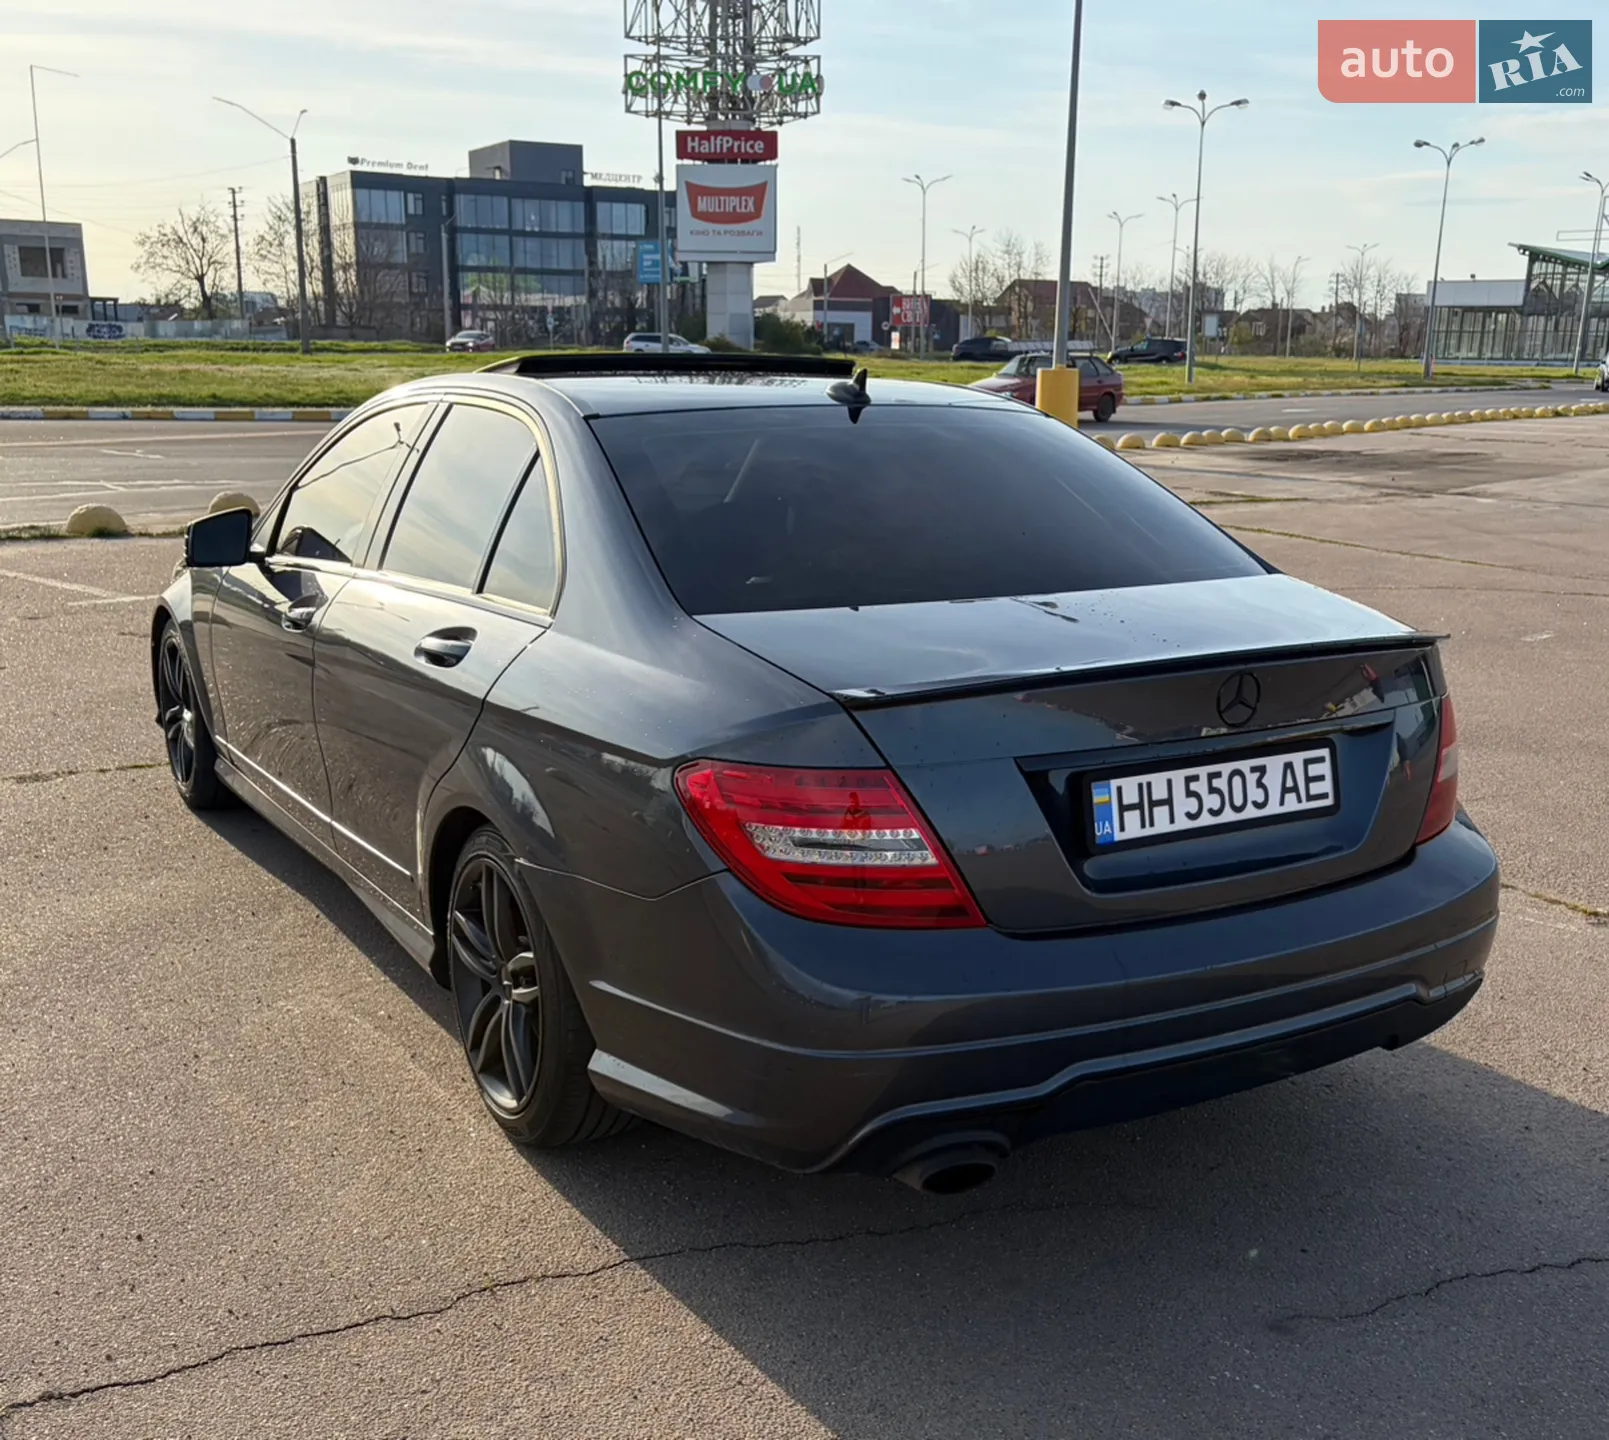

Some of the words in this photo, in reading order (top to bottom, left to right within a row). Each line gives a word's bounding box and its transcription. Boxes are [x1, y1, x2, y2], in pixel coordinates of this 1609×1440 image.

[627, 70, 747, 95] COMFY
[687, 135, 765, 154] HalfPrice
[360, 157, 404, 169] Premium
[697, 195, 756, 213] MULTIPLEX
[1116, 777, 1176, 833] HH
[1183, 763, 1270, 821] 5503
[1278, 755, 1330, 807] AE
[1094, 821, 1112, 836] UA
